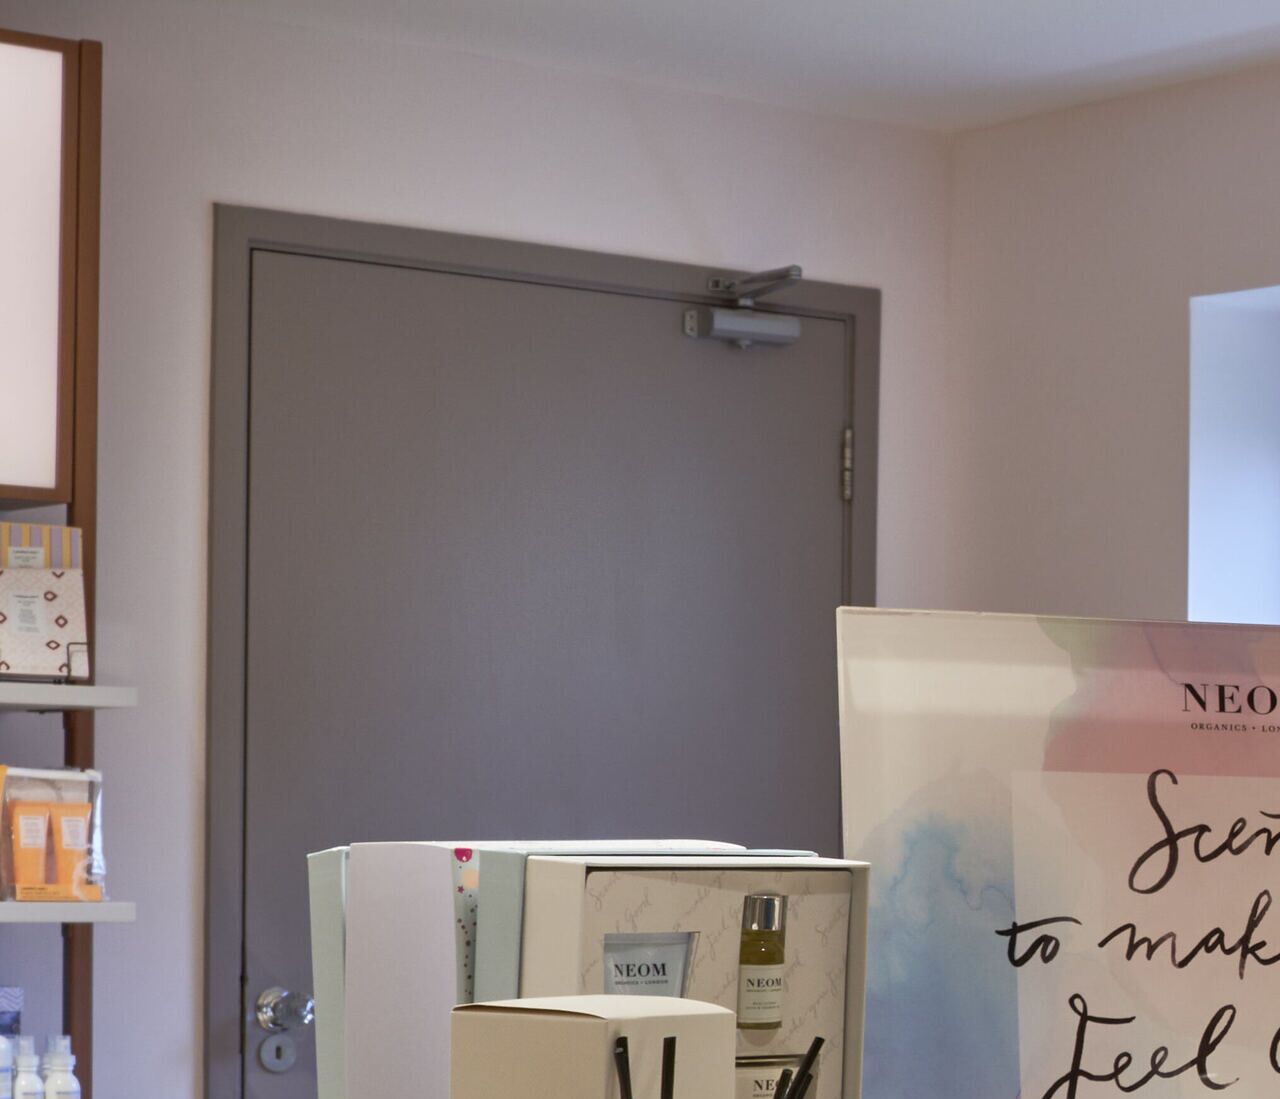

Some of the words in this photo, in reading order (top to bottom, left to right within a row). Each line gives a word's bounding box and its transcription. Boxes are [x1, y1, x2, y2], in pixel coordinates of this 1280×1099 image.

[1191, 723, 1246, 732] ORGANICS
[995, 916, 1082, 967] to
[613, 962, 667, 978] NEOM
